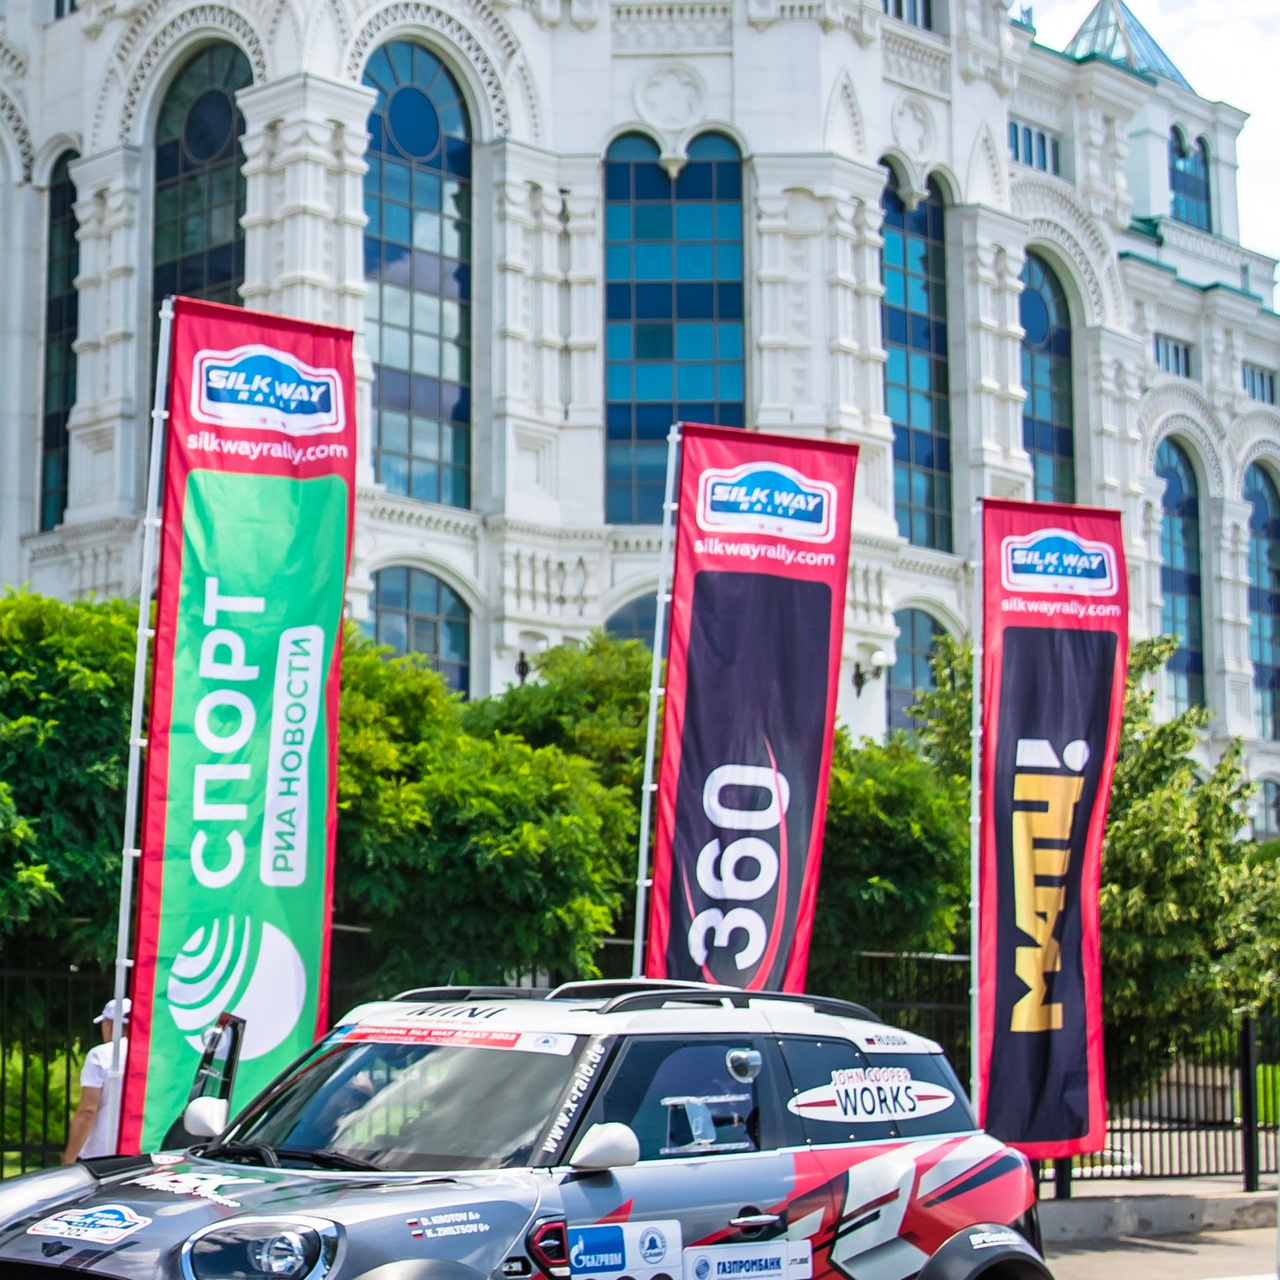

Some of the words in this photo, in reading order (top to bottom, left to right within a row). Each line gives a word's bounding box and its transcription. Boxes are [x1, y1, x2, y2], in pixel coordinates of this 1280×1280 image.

[207, 369, 272, 393] SILK
[274, 380, 327, 403] WAY
[237, 391, 298, 410] RALLY
[186, 431, 348, 466] silkwayrally.com
[712, 485, 771, 504] SILK
[773, 490, 822, 512] WAY
[693, 537, 836, 566] silkwayrally.com
[1012, 550, 1060, 566] SILK
[1062, 553, 1103, 570] WAY
[1001, 596, 1122, 619] silkwayrally.com
[278, 637, 312, 797] НОВОСТИ
[190, 576, 266, 890] СПОРТ
[271, 807, 297, 873] РИА
[686, 763, 791, 971] 360
[406, 1005, 508, 1019] MINI
[431, 1029, 453, 1038] WAY
[455, 1030, 488, 1040] RALLY
[832, 1070, 865, 1086] JOHN
[867, 1069, 910, 1083] COOPER
[542, 1043, 605, 1153] www.x-raid.de
[836, 1086, 917, 1116] WORKS
[431, 1212, 467, 1224] KROTOV
[716, 1257, 782, 1275] ГАЗПРОМБАНК
